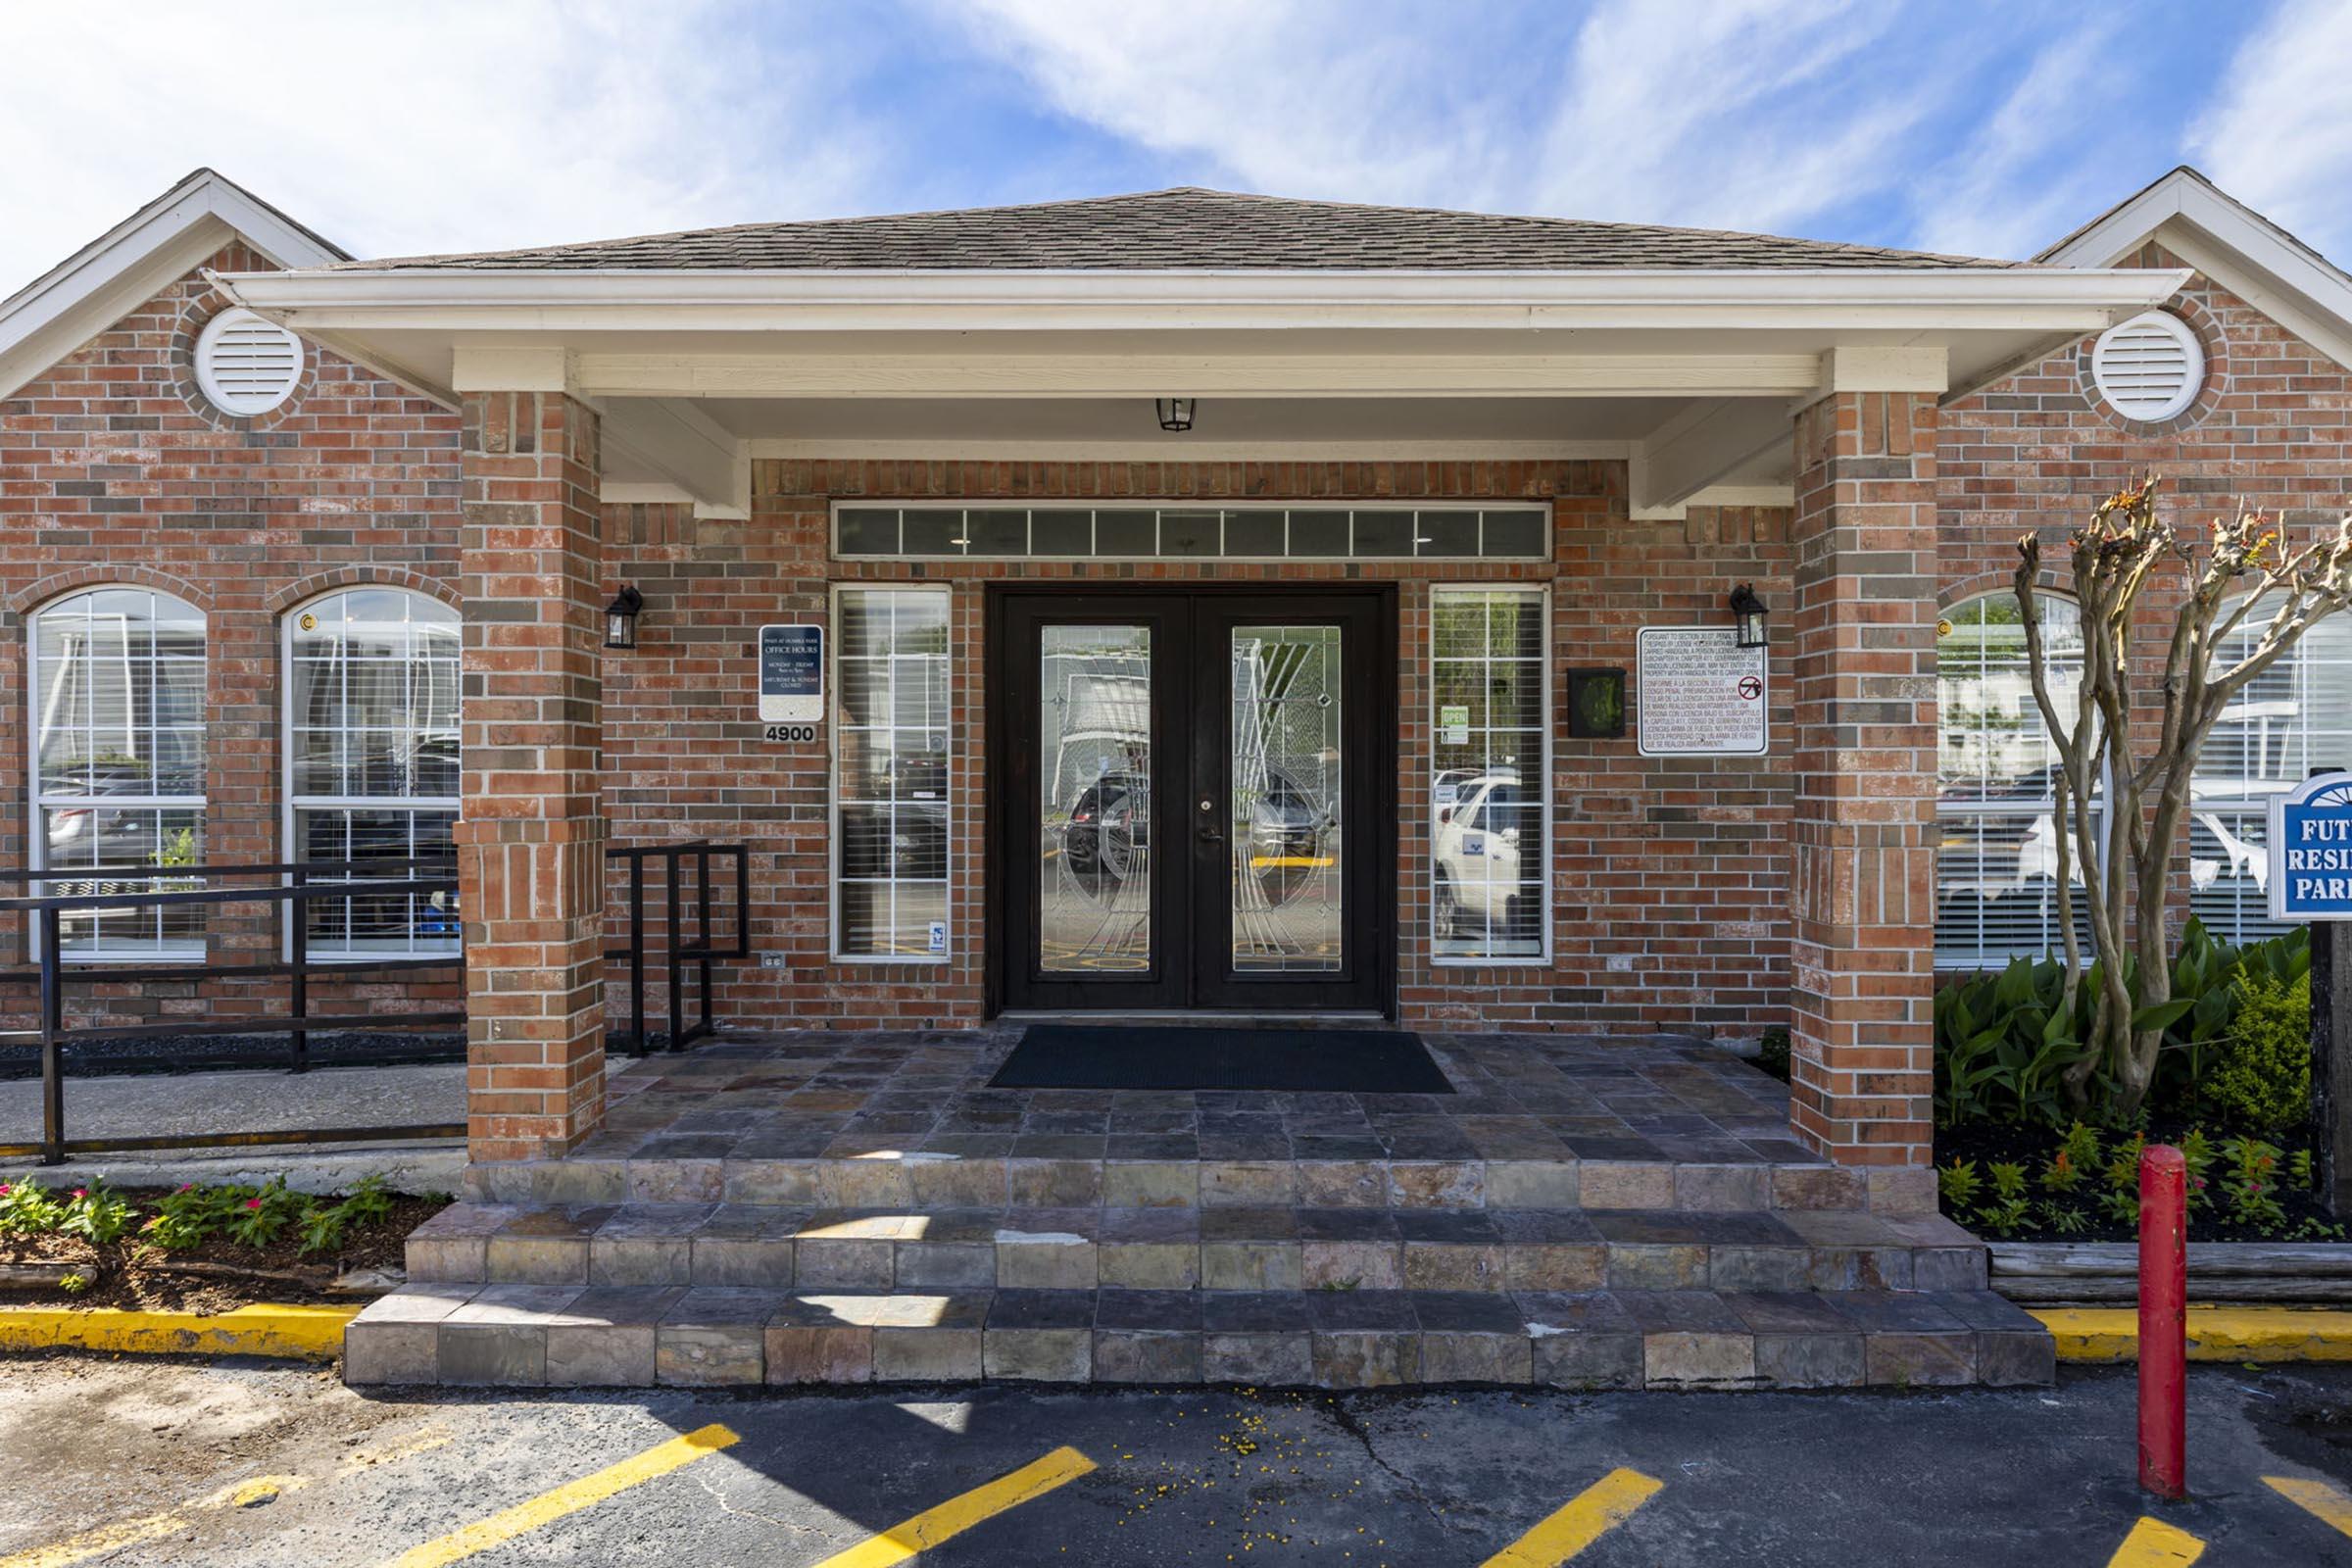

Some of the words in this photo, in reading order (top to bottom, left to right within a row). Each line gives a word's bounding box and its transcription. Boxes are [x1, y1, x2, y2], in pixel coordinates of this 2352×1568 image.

[1444, 712, 1466, 722] OPEN
[766, 726, 813, 741] 4900
[2301, 820, 2352, 841] FUT
[2288, 849, 2352, 870] RESI
[2296, 879, 2352, 900] PAR
